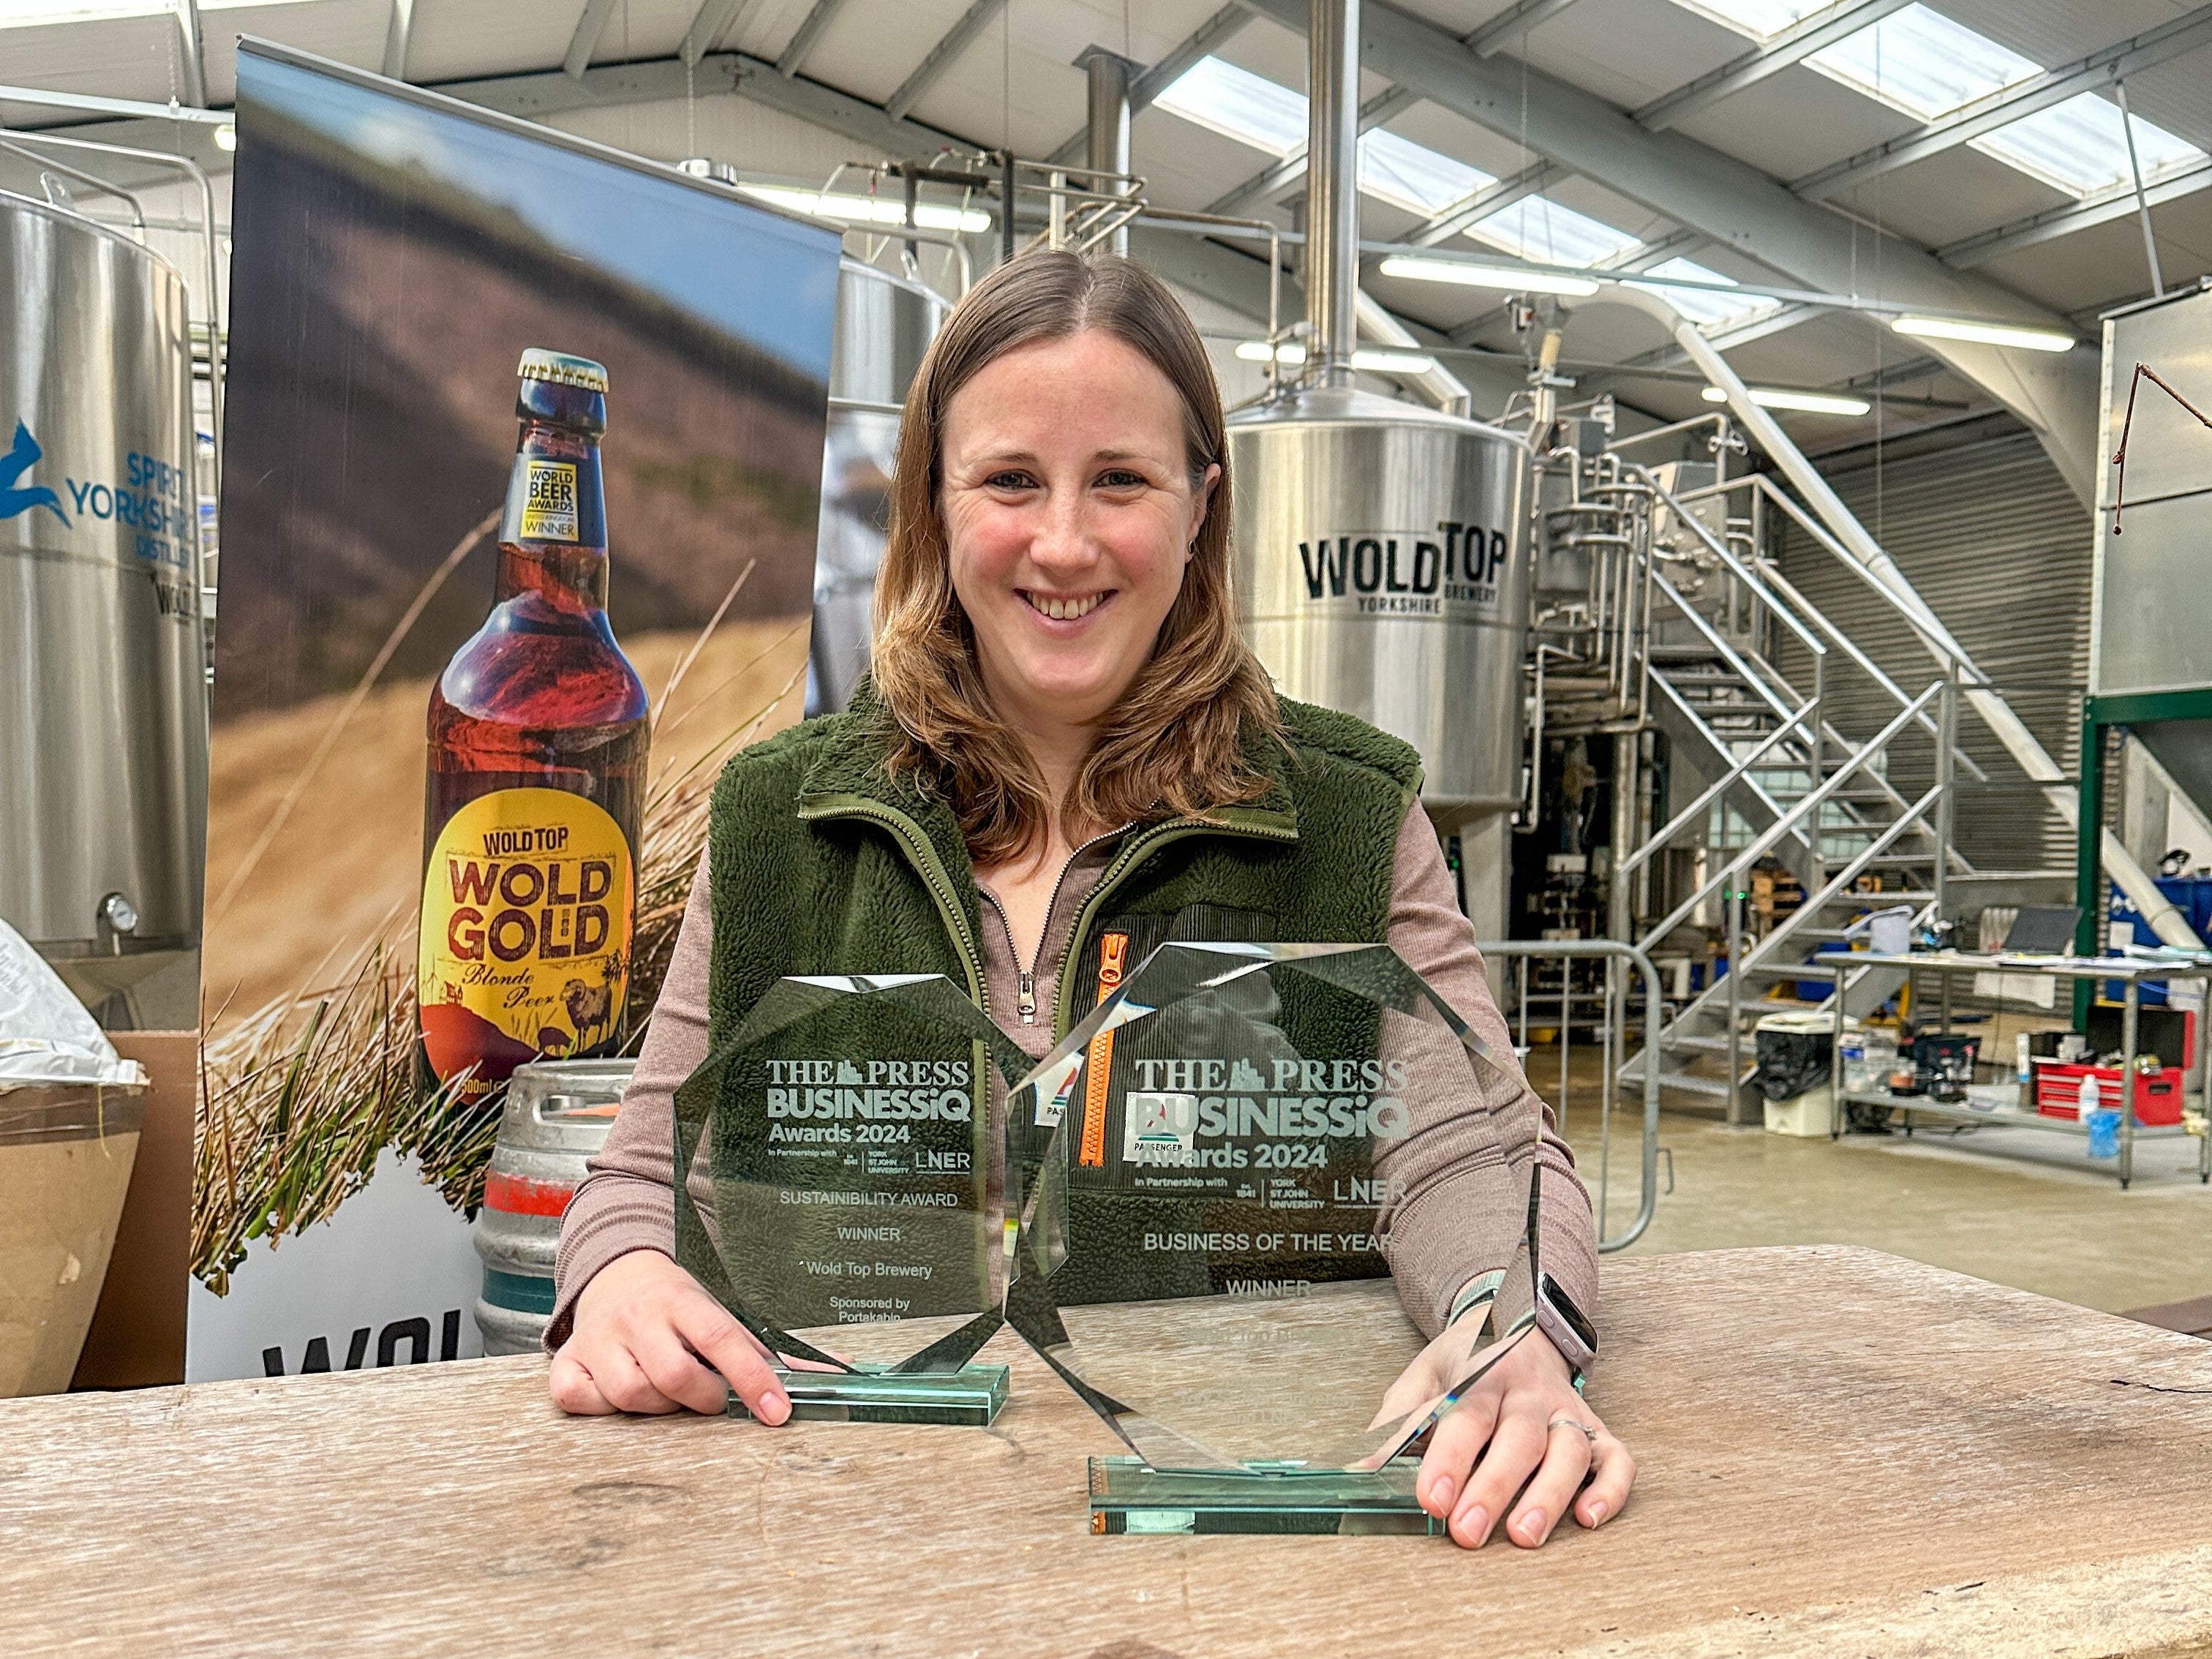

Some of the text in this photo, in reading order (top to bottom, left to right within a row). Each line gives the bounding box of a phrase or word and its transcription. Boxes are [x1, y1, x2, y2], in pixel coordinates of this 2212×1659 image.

[530, 470, 573, 484] WORLD
[530, 482, 573, 501] BEER
[527, 500, 574, 511] AWARDS
[525, 520, 574, 536] WINNER
[1299, 521, 1507, 599] WOLD TOP
[1357, 597, 1442, 615] YORKSHIRE
[484, 827, 569, 857] WOLD TOP
[448, 860, 613, 907] WOLD
[448, 904, 609, 962] GOLD
[462, 963, 535, 986] Blonde
[503, 986, 555, 1009] Beer
[767, 1060, 969, 1086] THE PRESS
[1135, 1059, 1409, 1093] THE PRESS
[767, 1088, 971, 1122] BUSINESSiQ
[1135, 1096, 1410, 1138] BUSINESSiQ
[769, 1124, 911, 1143] Awards 2024
[777, 1149, 819, 1158] Partnership
[1135, 1143, 1183, 1151] PASENGER
[1135, 1143, 1328, 1169] Awards 2024
[916, 1149, 971, 1170] LNER
[1135, 1177, 1228, 1189] In Partnership with
[1271, 1178, 1296, 1187] YORK
[1333, 1175, 1407, 1204] LNER
[780, 1192, 958, 1208] SUSTAINIBILITY AWARD
[1271, 1189, 1309, 1198] ST JOHN
[1270, 1200, 1325, 1209] UNIVERSITY
[838, 1227, 901, 1242] WINNER
[1145, 1233, 1250, 1252] BUSINESS
[1256, 1233, 1285, 1252] OF
[1290, 1233, 1333, 1252] THE
[807, 1261, 933, 1280] Wold Top Brewery
[1226, 1279, 1312, 1297] WINNER
[830, 1296, 911, 1312] Sponsored by
